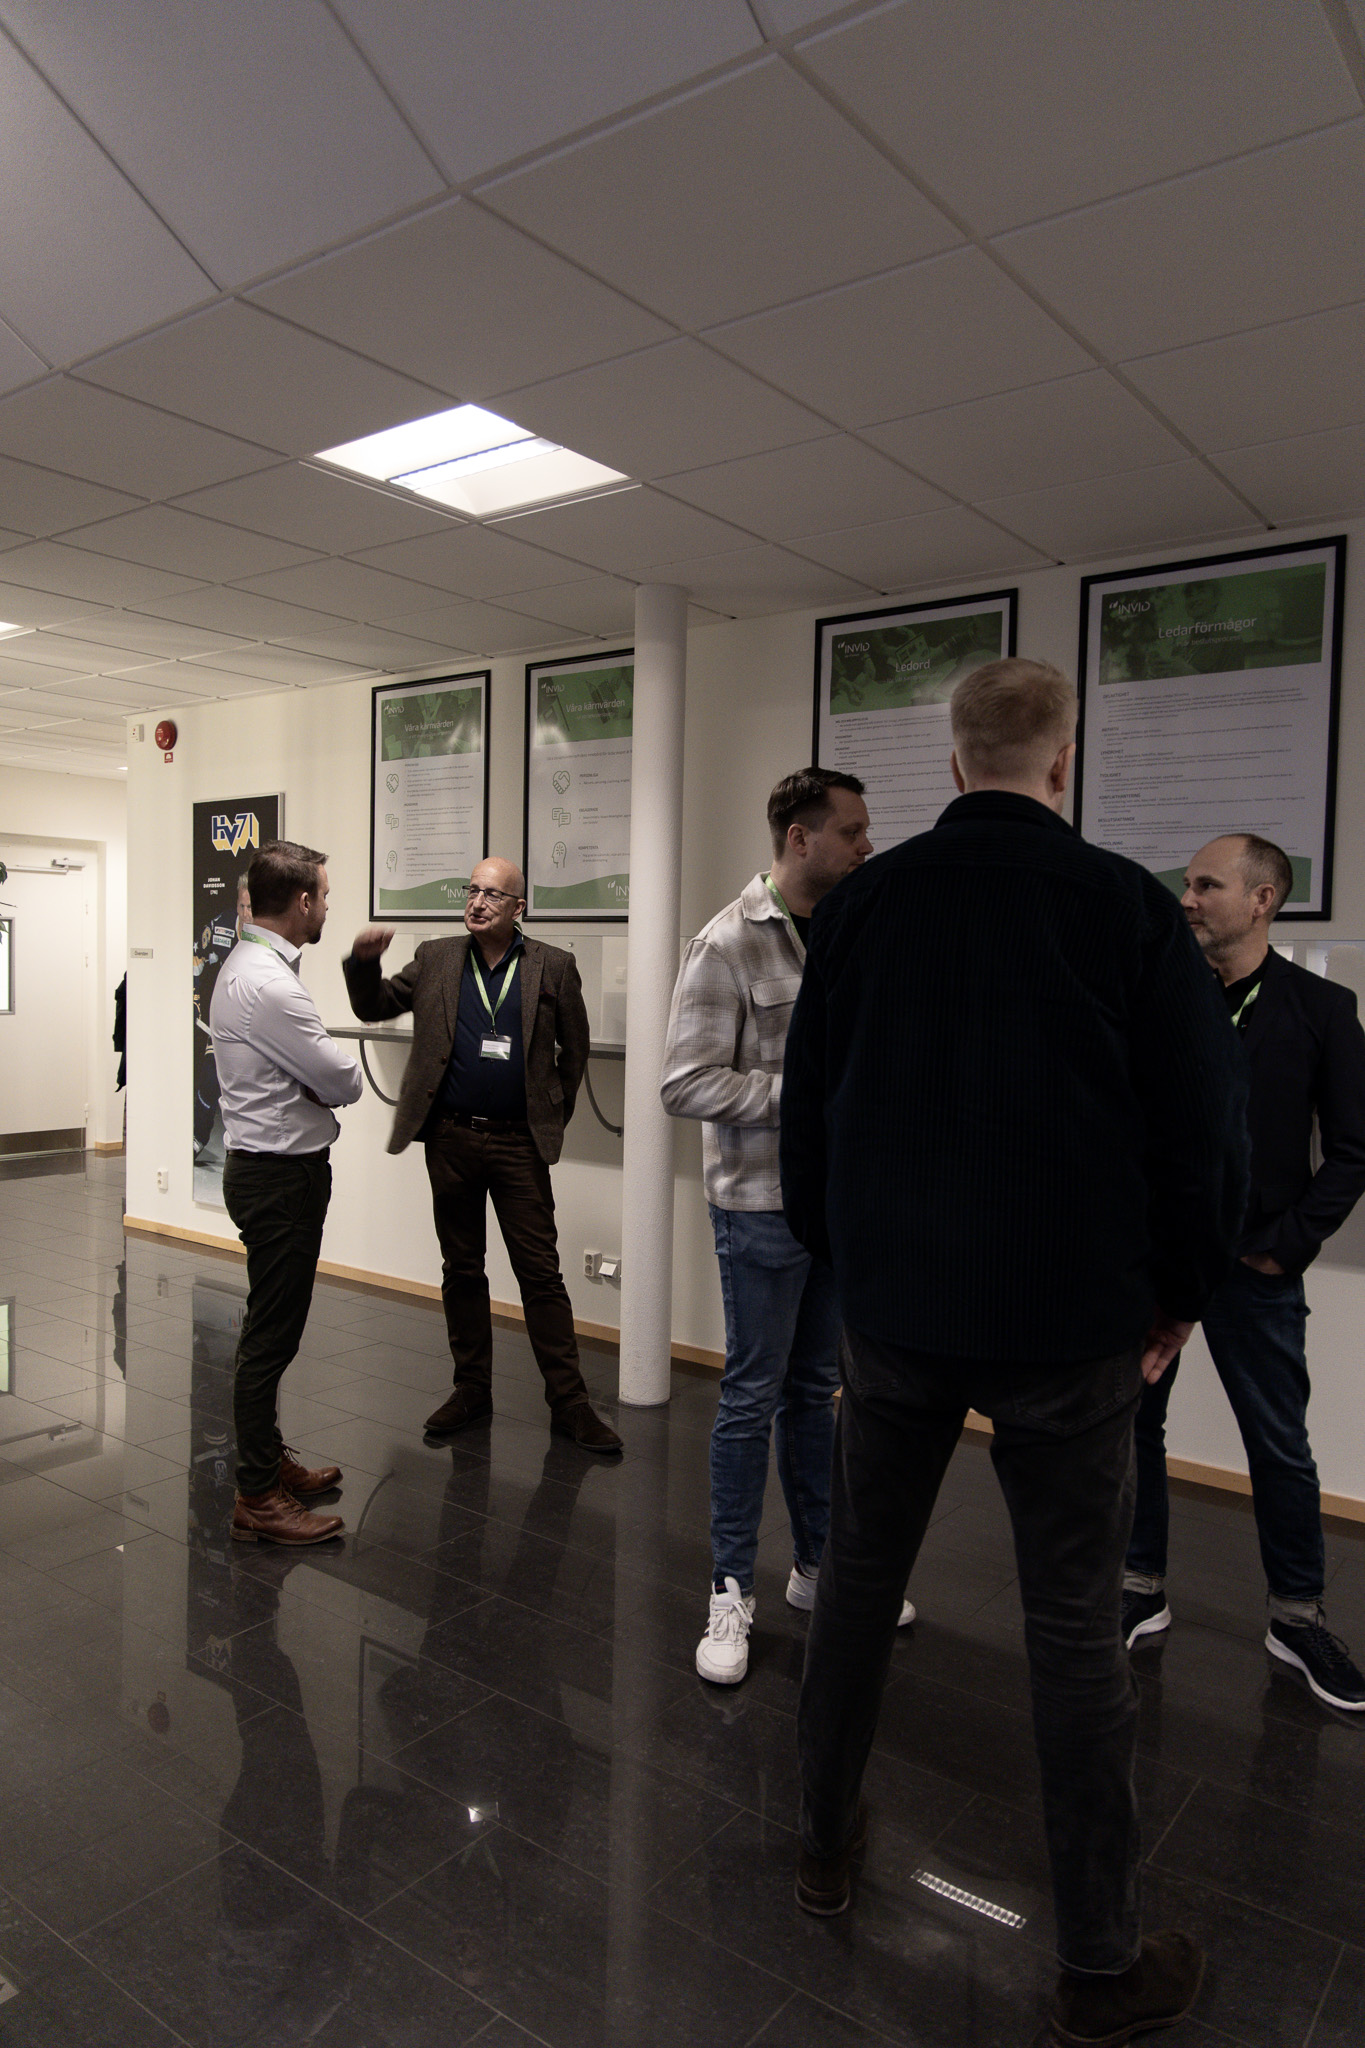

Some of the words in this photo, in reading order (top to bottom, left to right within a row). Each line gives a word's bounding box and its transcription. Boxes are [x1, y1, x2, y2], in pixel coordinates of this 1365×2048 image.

[1118, 601, 1151, 615] INVID
[1158, 617, 1258, 639] Ledarförmågor
[844, 642, 870, 655] INVID
[895, 659, 931, 673] Ledord
[545, 684, 566, 694] INVID
[565, 702, 583, 713] Våra
[583, 699, 626, 712] kärnvärden
[404, 722, 419, 733] Våra
[420, 719, 455, 731] kärnvärden
[212, 812, 260, 857] HV71
[615, 885, 630, 897] IN
